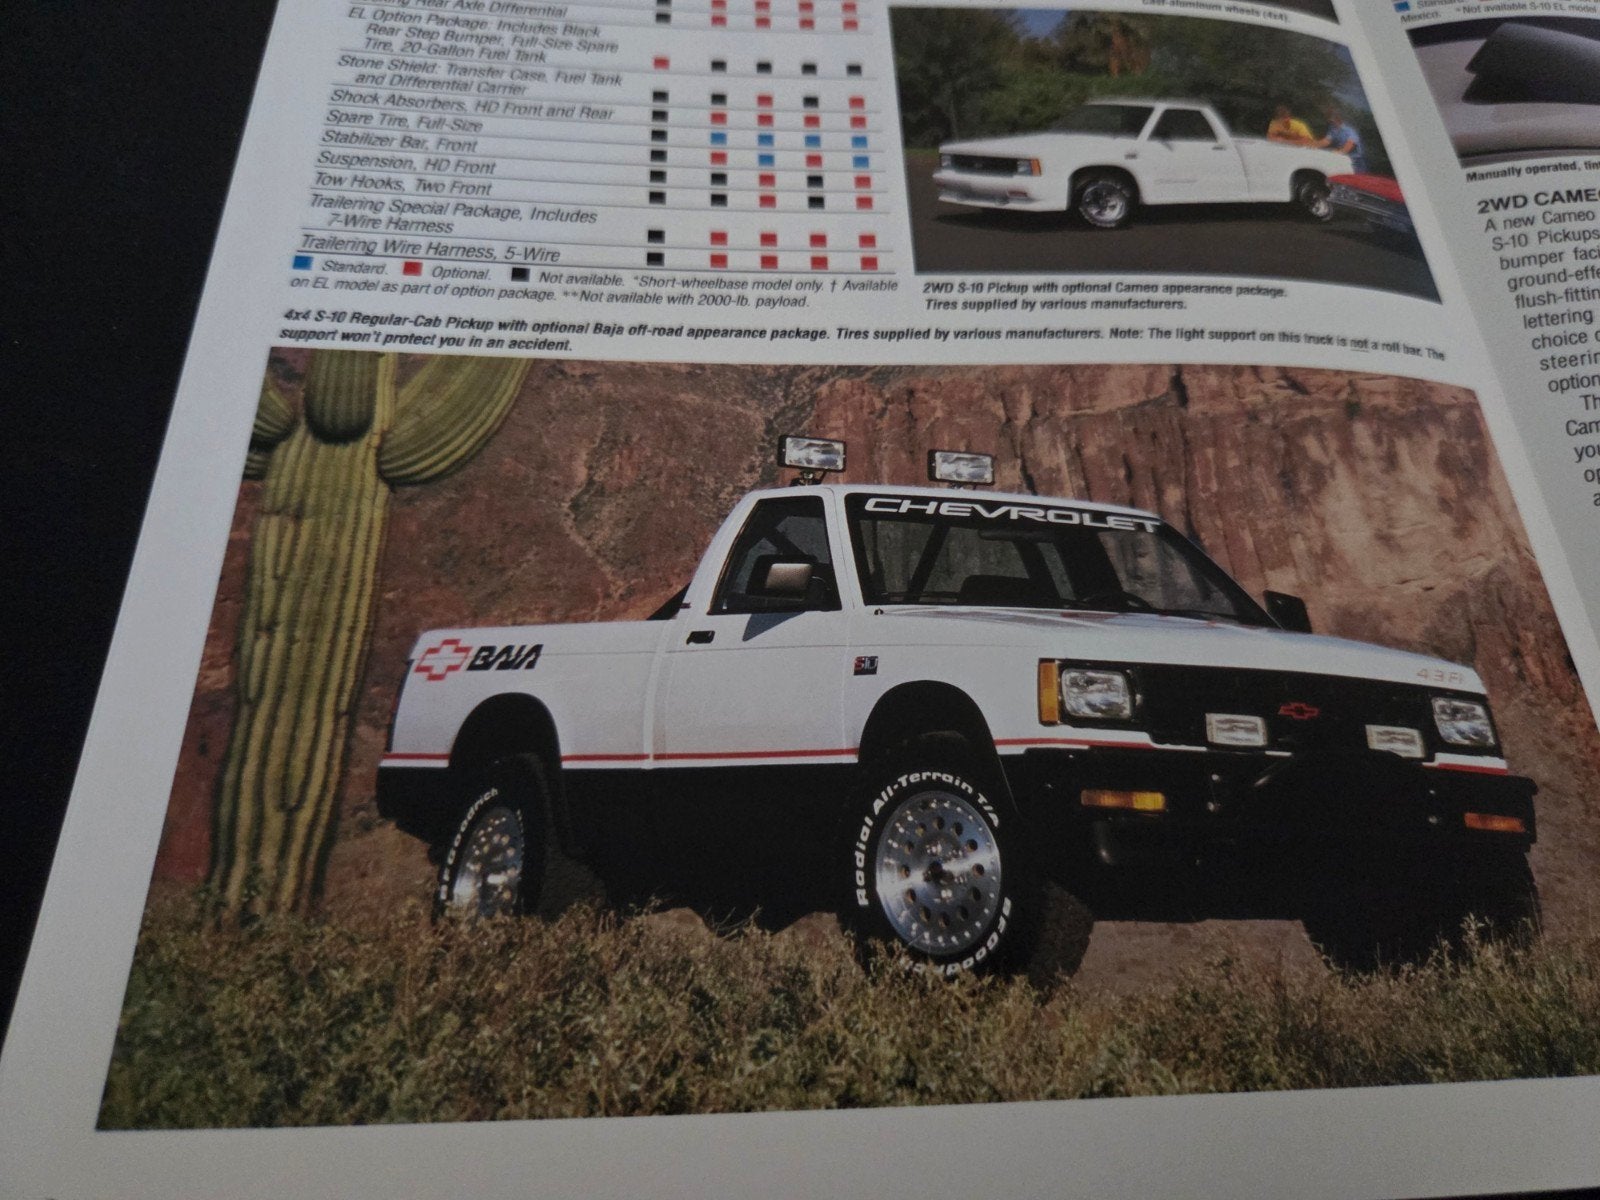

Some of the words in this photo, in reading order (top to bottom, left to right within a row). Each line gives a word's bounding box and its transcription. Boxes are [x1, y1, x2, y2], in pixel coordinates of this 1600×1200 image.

[330, 89, 382, 103] Shock
[384, 93, 466, 112] Absorbers,
[473, 99, 500, 114] HD
[502, 100, 544, 117] Front
[544, 105, 576, 118] and
[578, 104, 615, 122] Rear
[326, 109, 374, 128] Spare
[378, 113, 410, 129] Tire,
[416, 116, 483, 134] Full-Size
[322, 130, 396, 146] Stabilizer
[400, 135, 429, 152] Bar,
[435, 136, 478, 153] Front
[317, 150, 416, 170] Suspension,
[423, 157, 451, 172] HD
[452, 158, 497, 175] Front
[1466, 166, 1522, 182] Manually
[315, 170, 348, 186] Tow
[350, 175, 405, 193] Hooks,
[414, 177, 446, 193] Two
[448, 179, 492, 196] Front
[310, 192, 386, 214] Trailering
[387, 198, 450, 216] Special
[452, 201, 522, 221] Package,
[529, 206, 598, 224] Includes
[1477, 195, 1528, 214] 2WD
[327, 214, 382, 229] 7-Wire
[384, 215, 454, 234] Harness
[1484, 218, 1497, 233] A
[1503, 215, 1535, 230] new
[1542, 210, 1595, 224] Cameo
[301, 234, 378, 254] Trailering
[382, 238, 422, 255] Wire
[427, 242, 497, 260] Harness,
[505, 246, 560, 262] 5-Wire
[1492, 234, 1528, 252] S-10
[321, 259, 388, 275] Standard.
[1500, 249, 1564, 270] bumper
[430, 264, 491, 280] Optional.
[538, 270, 564, 284] Not
[564, 273, 624, 286] available.
[751, 278, 793, 290] model
[794, 279, 823, 293] only.
[841, 279, 898, 291] Available
[289, 277, 310, 287] on
[311, 276, 329, 289] EL
[333, 279, 380, 291] model
[380, 282, 399, 292] as
[399, 283, 432, 295] part
[432, 283, 450, 295] of
[450, 284, 495, 298] option
[496, 287, 556, 302] package.
[605, 291, 663, 304] available
[665, 292, 694, 305] with
[696, 292, 750, 307] 2000-lb.
[754, 294, 809, 309] payload.
[922, 281, 954, 293] 2WD
[957, 280, 985, 293] S-10
[986, 281, 1029, 295] Pickup
[1032, 281, 1059, 293] with
[1061, 281, 1112, 295] optional
[1114, 281, 1160, 293] Cameo
[1162, 283, 1234, 295] appearance
[1235, 284, 1287, 299] package.
[925, 297, 958, 310] Tires
[961, 297, 1019, 312] supplied
[1020, 297, 1038, 312] by
[1039, 297, 1088, 309] various
[1090, 297, 1186, 309] manufacturers.
[1524, 309, 1594, 330] lettering
[278, 328, 339, 342] support
[339, 330, 382, 343] won't
[381, 332, 437, 346] protect
[437, 336, 466, 348] you
[468, 335, 483, 347] in
[485, 337, 505, 348] an
[507, 337, 572, 351] accident.
[283, 308, 312, 321] 4x4
[313, 309, 348, 323] S-10
[348, 311, 442, 327] Regular-Cab
[444, 316, 494, 333] Pickup
[497, 319, 528, 331] with
[531, 321, 590, 335] optional
[592, 321, 624, 337] Baja
[627, 323, 684, 337] off-road
[686, 327, 767, 340] appearance
[769, 327, 830, 342] package.
[836, 326, 869, 339] Tires
[872, 327, 931, 342] supplied
[933, 327, 950, 342] by
[953, 327, 1002, 339] various
[1005, 327, 1103, 339] manufacturers.
[1109, 327, 1143, 339] Note:
[1147, 327, 1172, 339] The
[1175, 327, 1205, 341] light
[1208, 330, 1257, 342] support
[1259, 332, 1275, 341] on
[1277, 331, 1301, 343] this
[1303, 333, 1334, 345] truck
[1336, 336, 1347, 346] is
[1350, 338, 1369, 349] not
[1371, 341, 1379, 350] a
[1381, 341, 1401, 353] roll
[1402, 343, 1422, 357] bar.
[1425, 347, 1445, 361] The
[1532, 330, 1588, 350] choice
[864, 497, 1161, 534] CHEVROLET
[872, 771, 974, 816] All-Terrain
